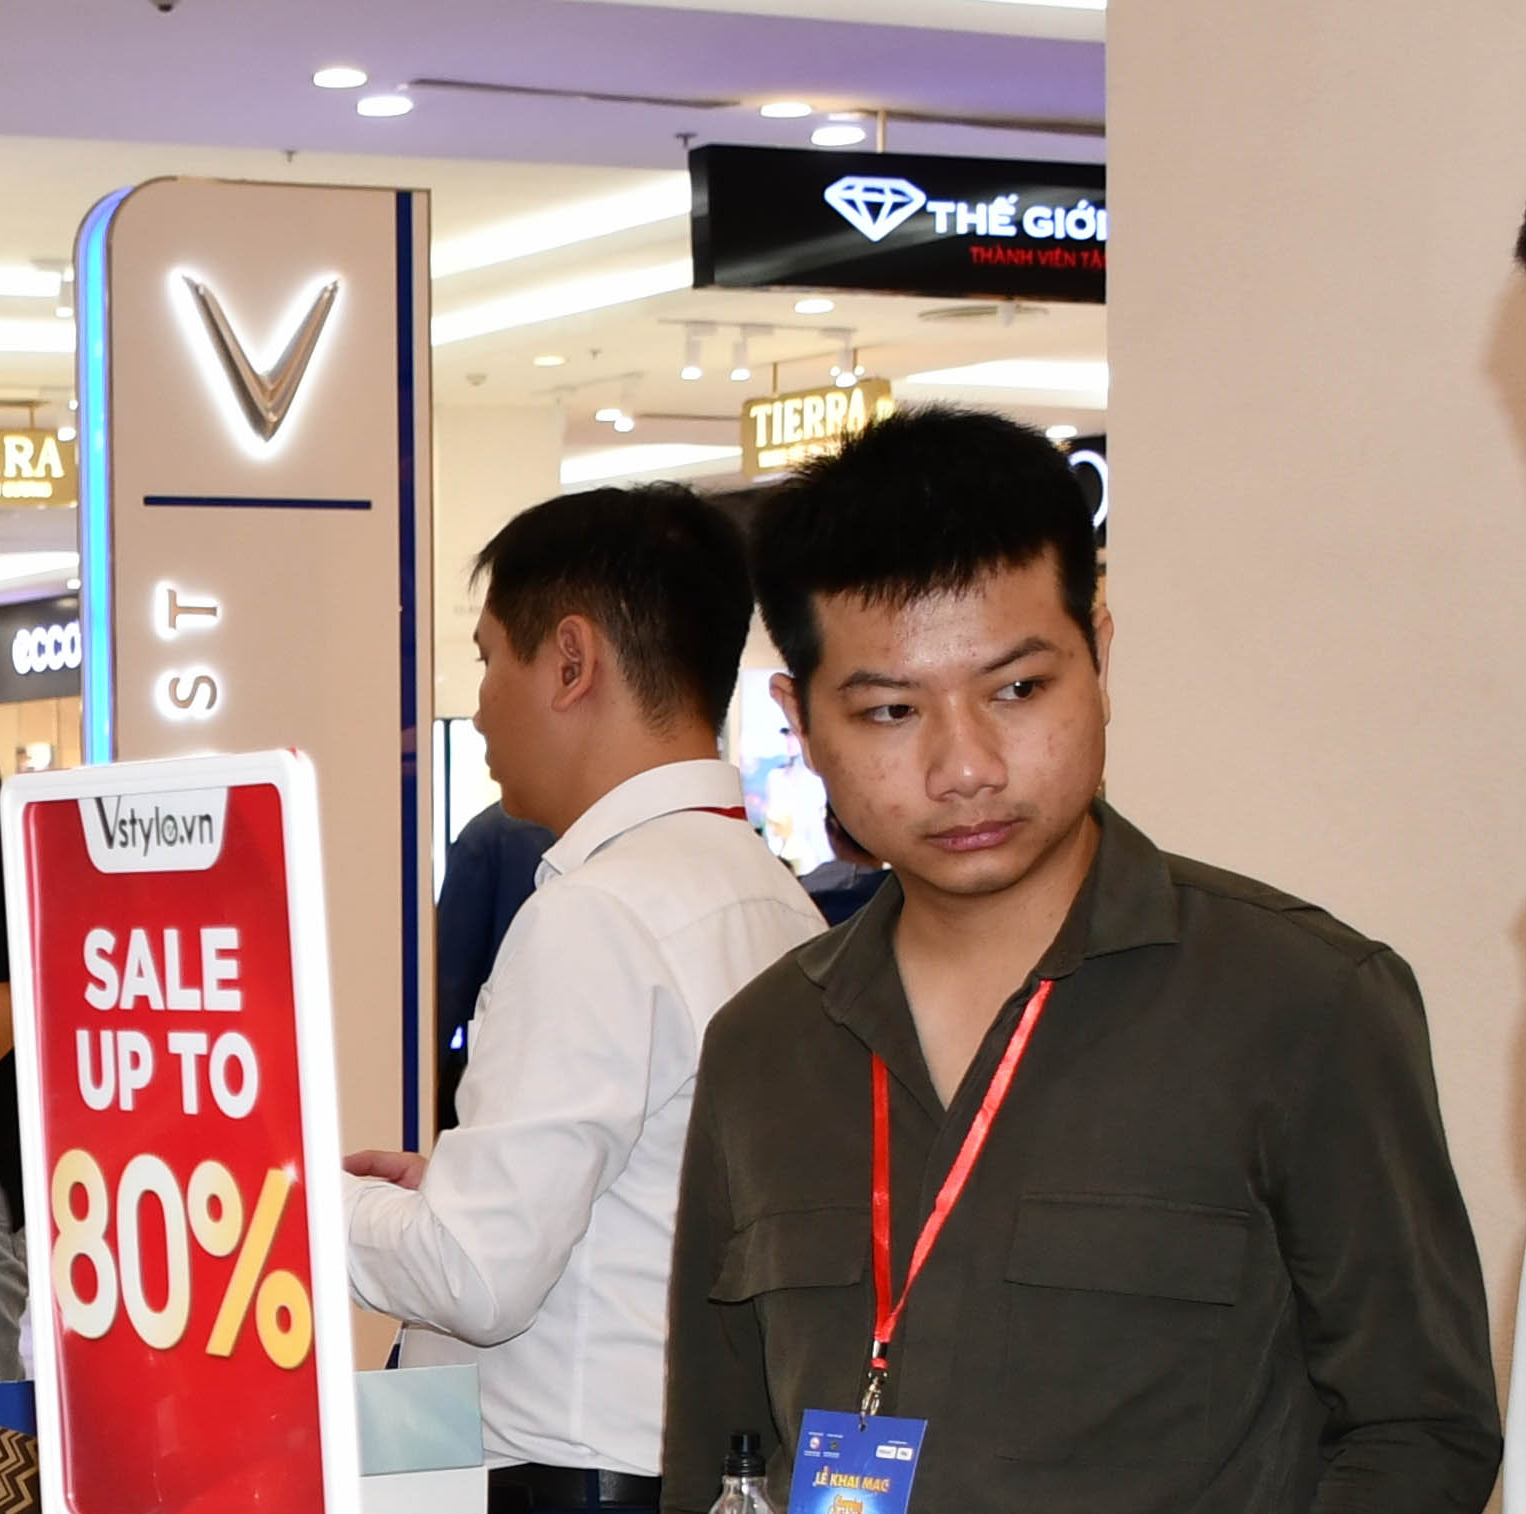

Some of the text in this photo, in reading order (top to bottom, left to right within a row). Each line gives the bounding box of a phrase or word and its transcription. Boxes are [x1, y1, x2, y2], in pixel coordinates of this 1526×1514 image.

[926, 195, 1016, 239] THẾ
[750, 385, 864, 449] TIERRA
[83, 927, 242, 1012] SALE
[75, 1028, 259, 1120] UP TO
[51, 1148, 313, 1370] 80%
[829, 1472, 860, 1489] KHAI
